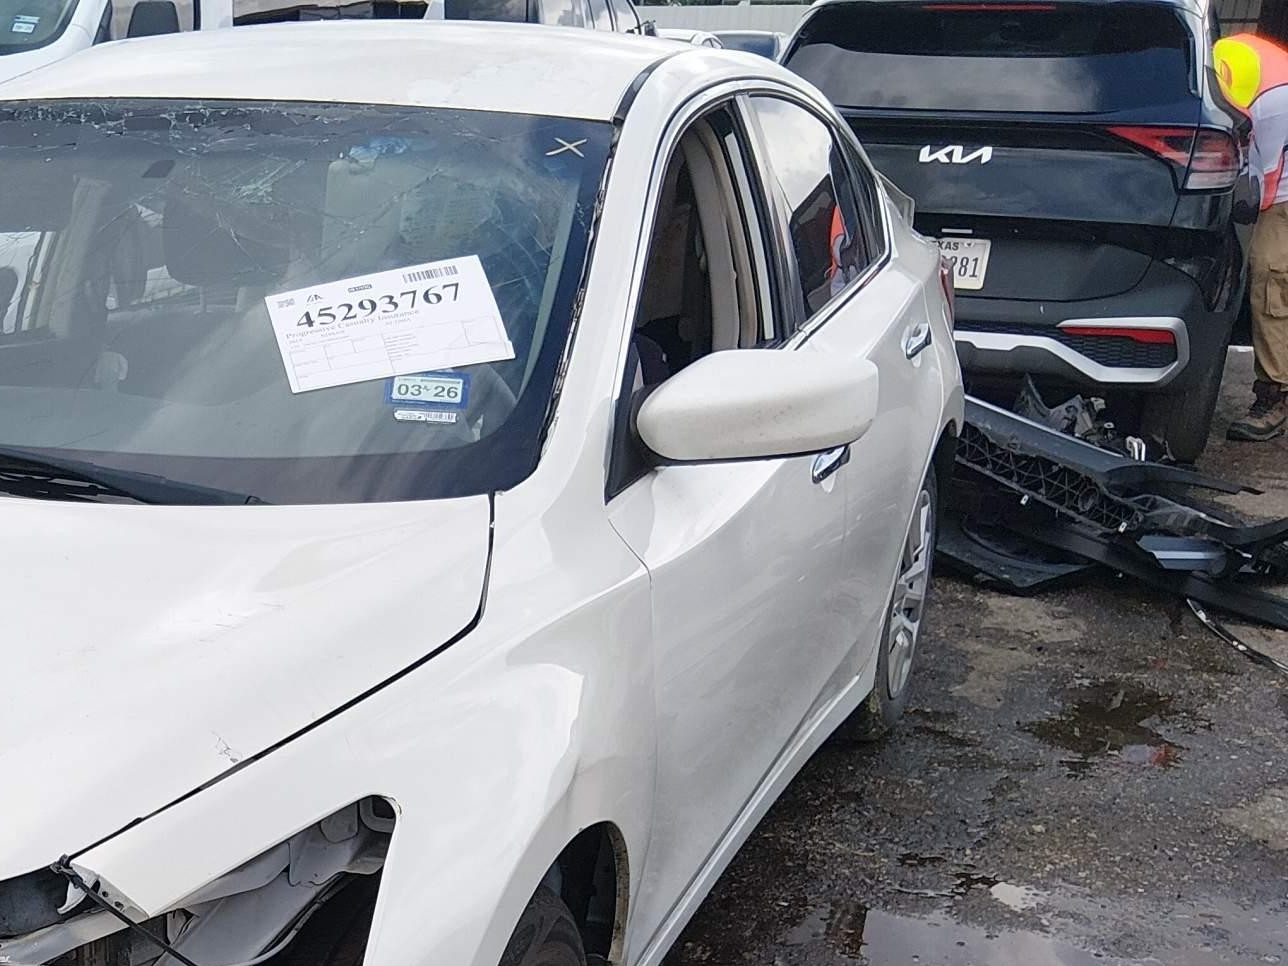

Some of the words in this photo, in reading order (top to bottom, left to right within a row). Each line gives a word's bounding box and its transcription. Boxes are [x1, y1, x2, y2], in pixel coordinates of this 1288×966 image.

[937, 241, 960, 251] XAS
[296, 282, 459, 328] 45293767
[397, 383, 422, 397] 03
[433, 385, 459, 399] 26
